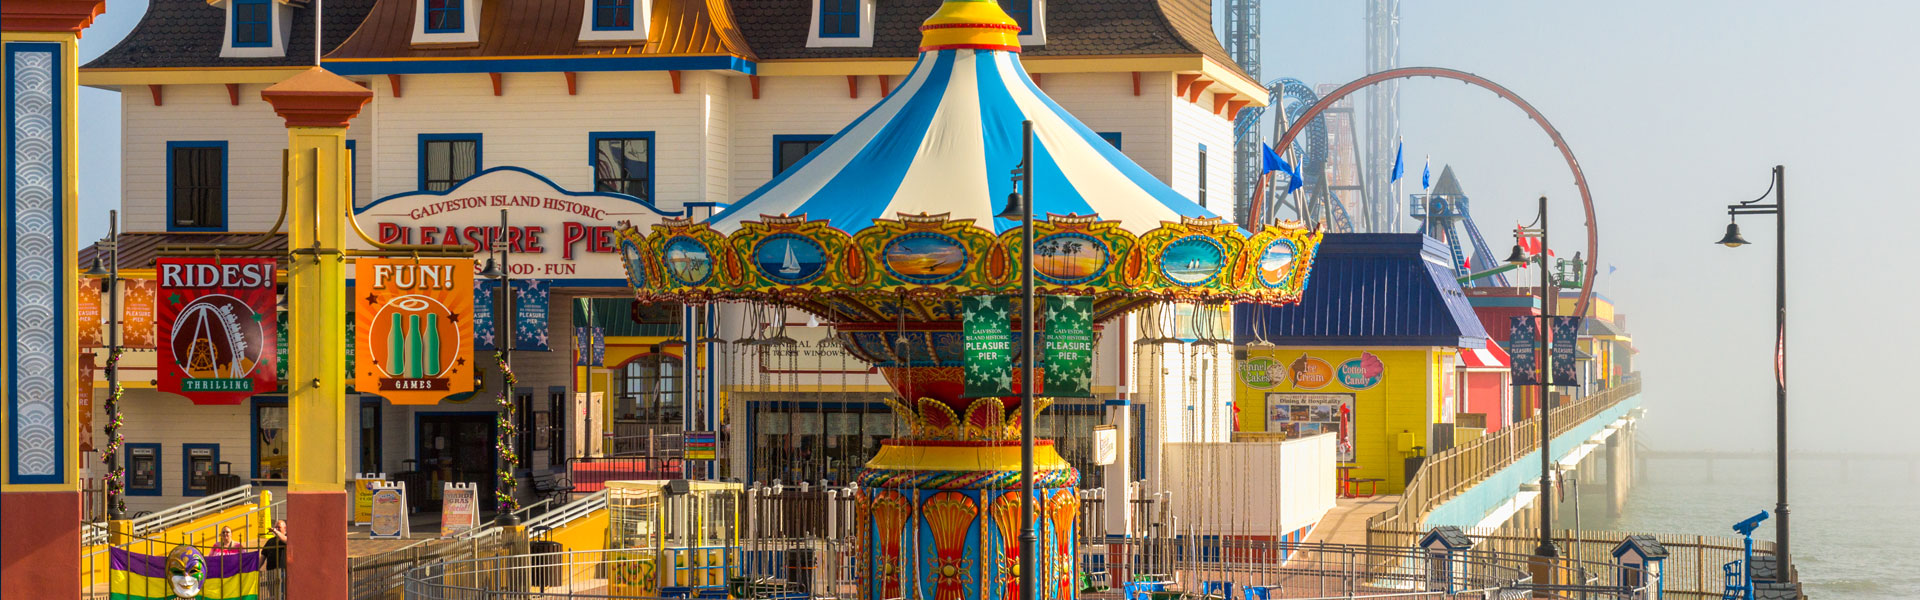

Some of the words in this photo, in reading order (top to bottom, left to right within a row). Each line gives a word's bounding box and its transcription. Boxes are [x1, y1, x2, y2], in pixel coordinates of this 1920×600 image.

[410, 196, 487, 220] GALVESTON
[490, 195, 540, 207] ISLAND
[543, 198, 606, 220] HISTORIC
[563, 222, 620, 260] PIE
[545, 263, 577, 275] FUN
[161, 263, 272, 288] RIDES!
[373, 264, 455, 289] FUN!
[965, 341, 1010, 351] PLEASURE
[1046, 341, 1091, 351] PLEASURE
[772, 349, 799, 357] TCKET
[978, 352, 998, 360] PIER
[1058, 351, 1078, 361] PIER
[1304, 362, 1317, 372] Ice
[1342, 364, 1367, 375] Cotton
[1296, 371, 1325, 383] Cream
[1344, 374, 1371, 387] Candy
[186, 380, 249, 390] THRILLING
[395, 380, 432, 390] GAMES
[1308, 398, 1341, 406] Hospitality
